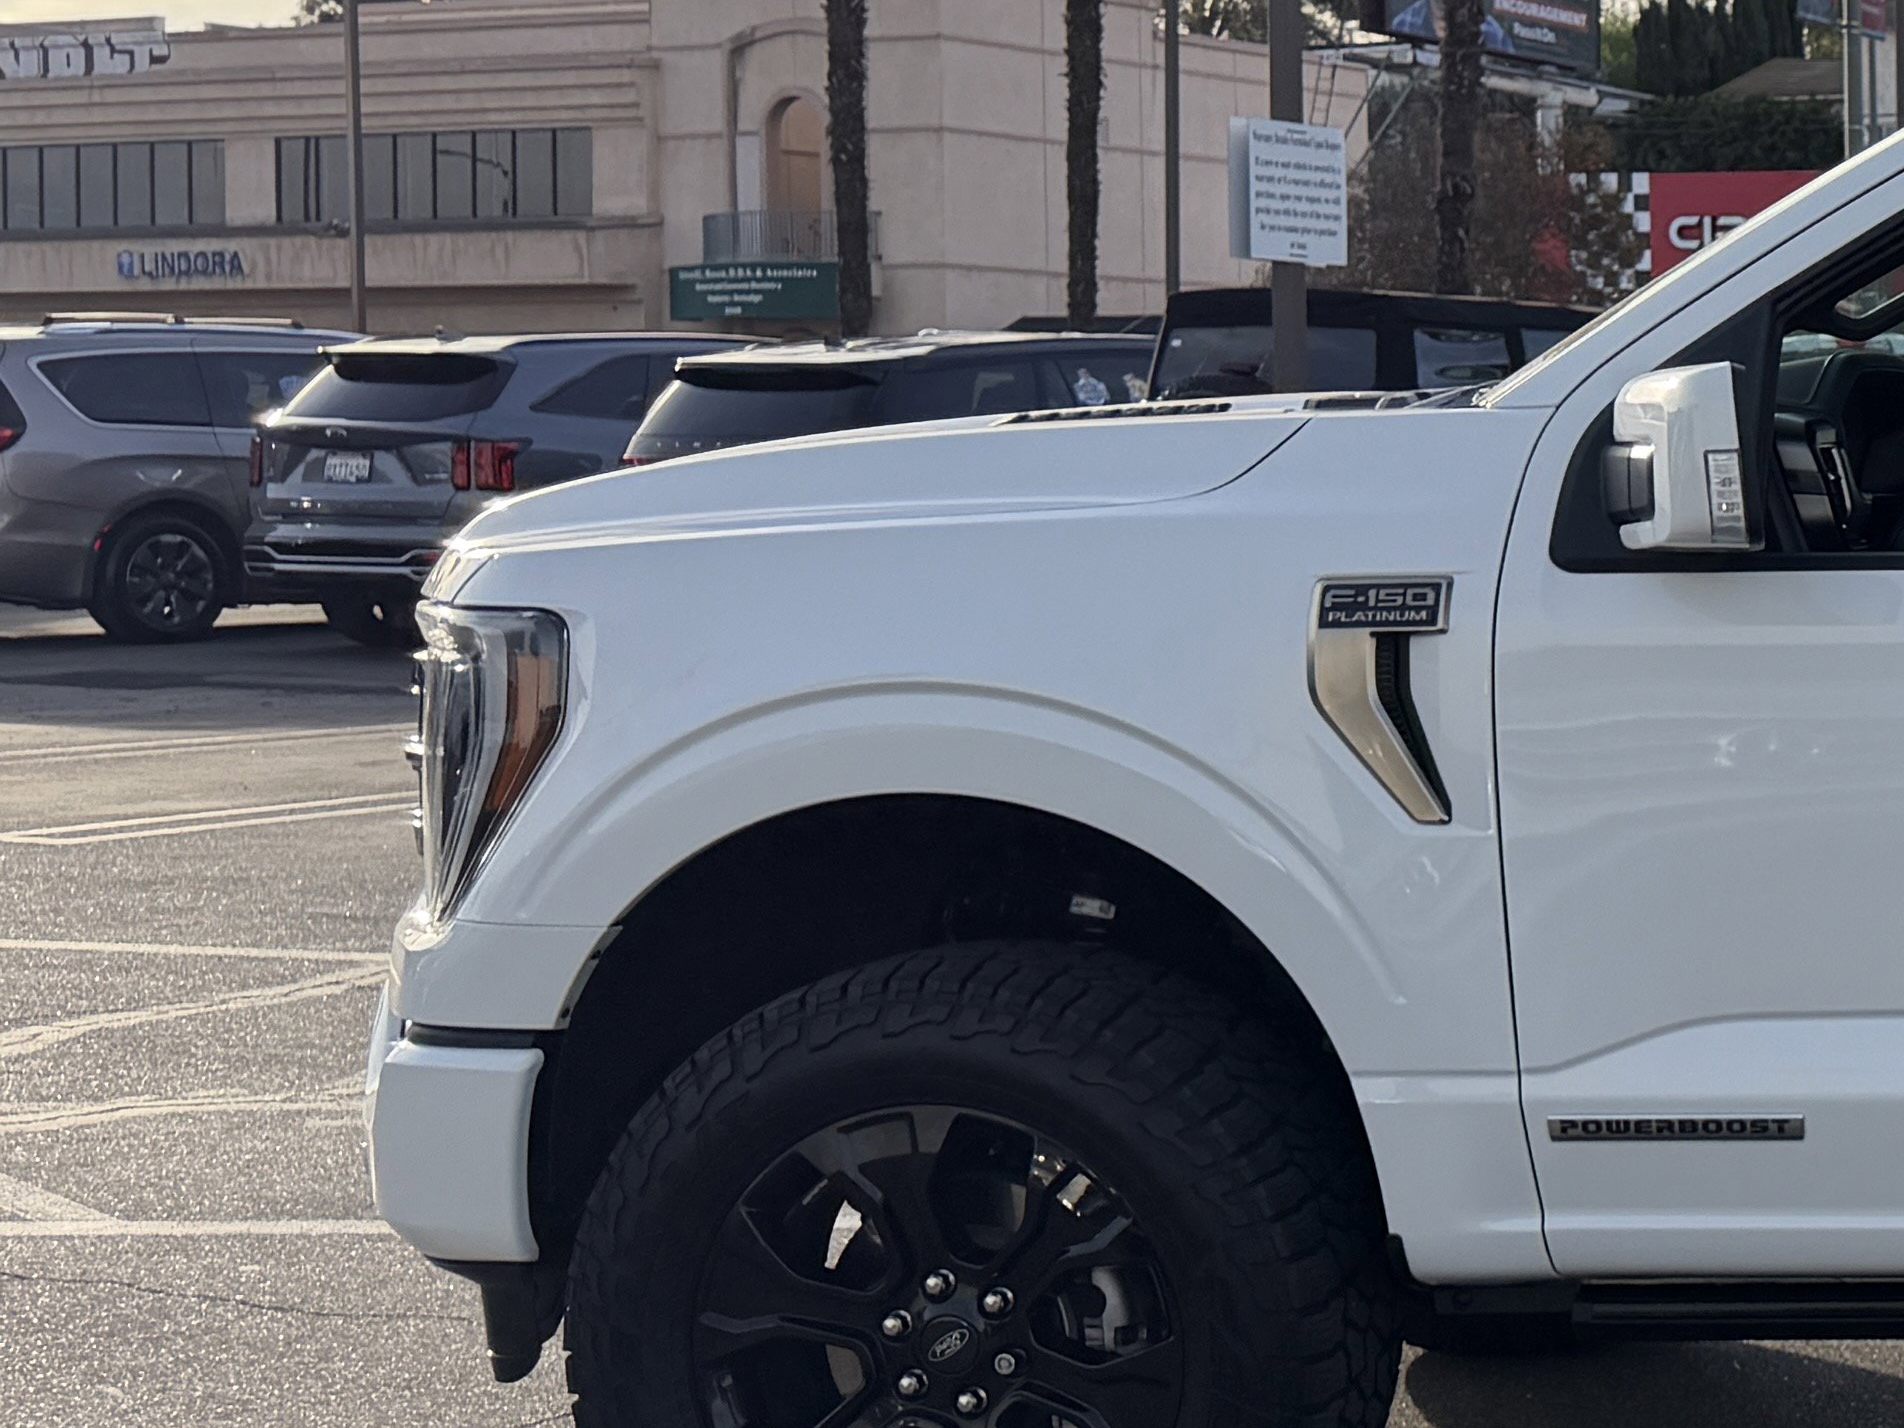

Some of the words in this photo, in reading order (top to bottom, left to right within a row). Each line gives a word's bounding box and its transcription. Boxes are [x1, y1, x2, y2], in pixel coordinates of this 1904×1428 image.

[140, 250, 245, 278] LINDORA
[1324, 587, 1437, 608] F-150
[1328, 609, 1427, 622] PLATINUM
[1558, 1118, 1793, 1136] POWERBOOST
